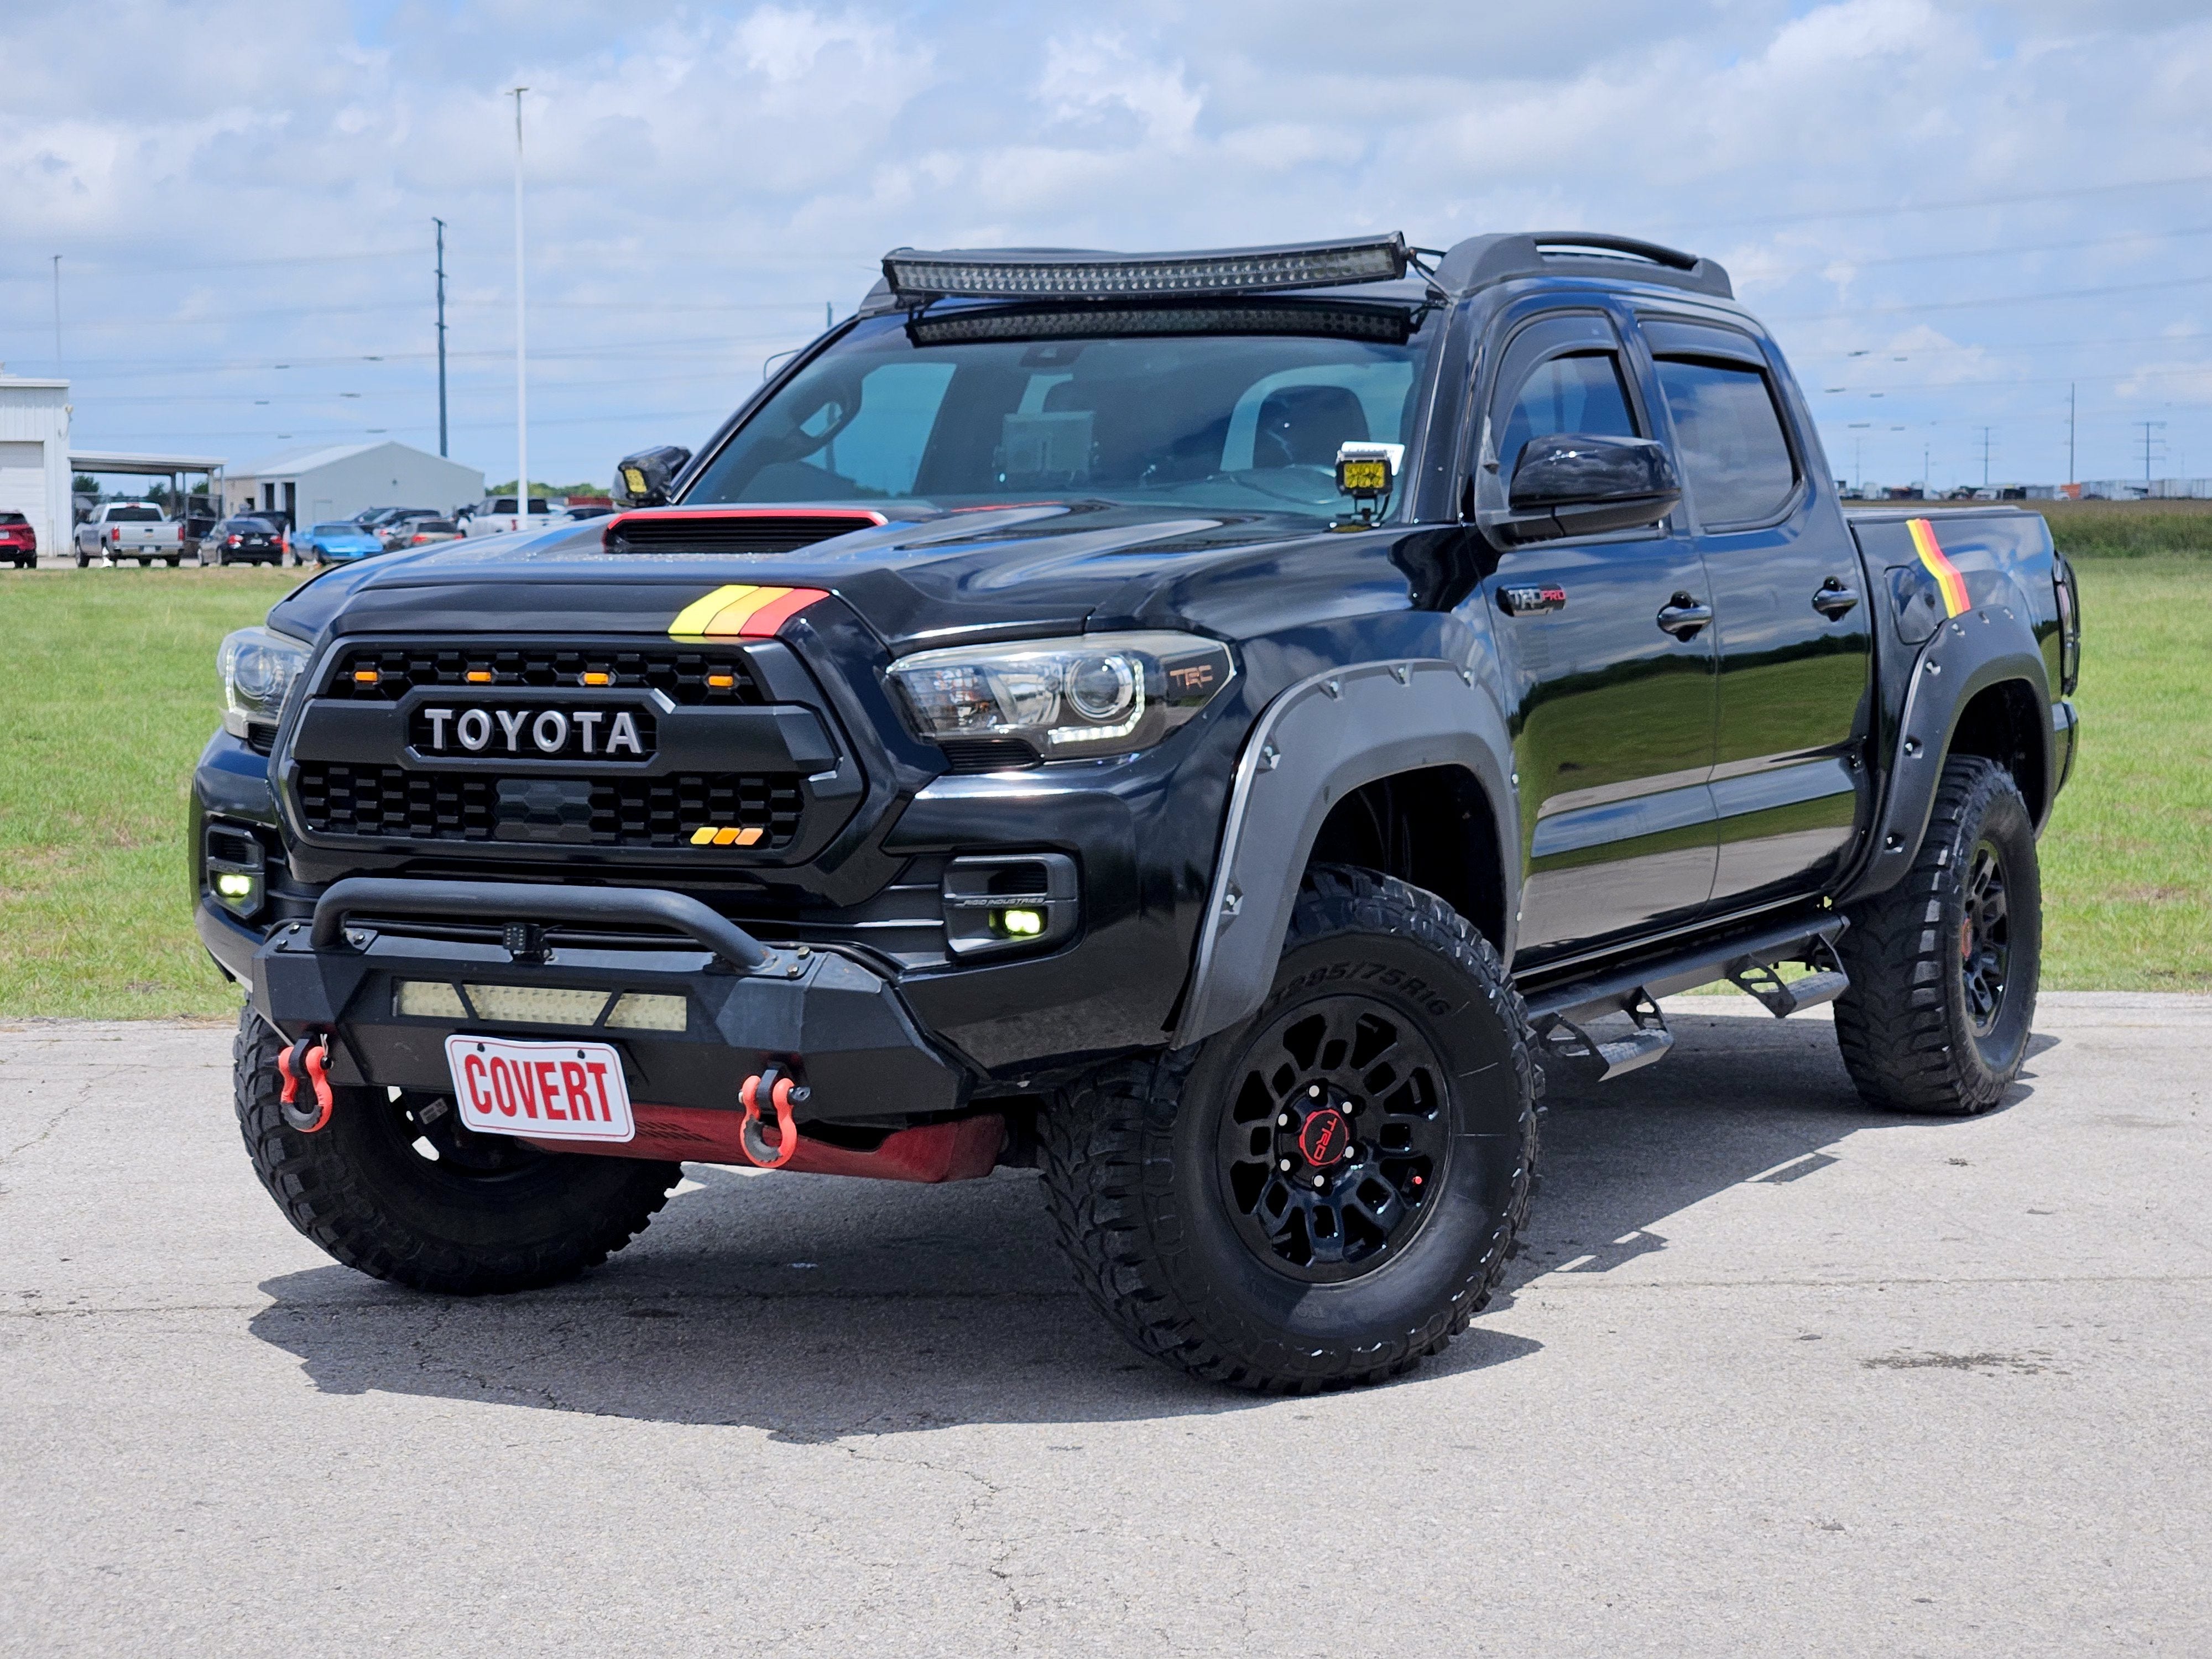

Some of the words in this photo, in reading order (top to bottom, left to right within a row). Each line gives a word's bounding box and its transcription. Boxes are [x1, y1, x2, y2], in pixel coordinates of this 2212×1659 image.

[1541, 590, 1566, 601] PRO
[425, 708, 642, 754] TOYOTA
[985, 898, 1044, 906] INDUSTRIES
[465, 1053, 612, 1122] COVERT
[1313, 1118, 1337, 1160] TRD
